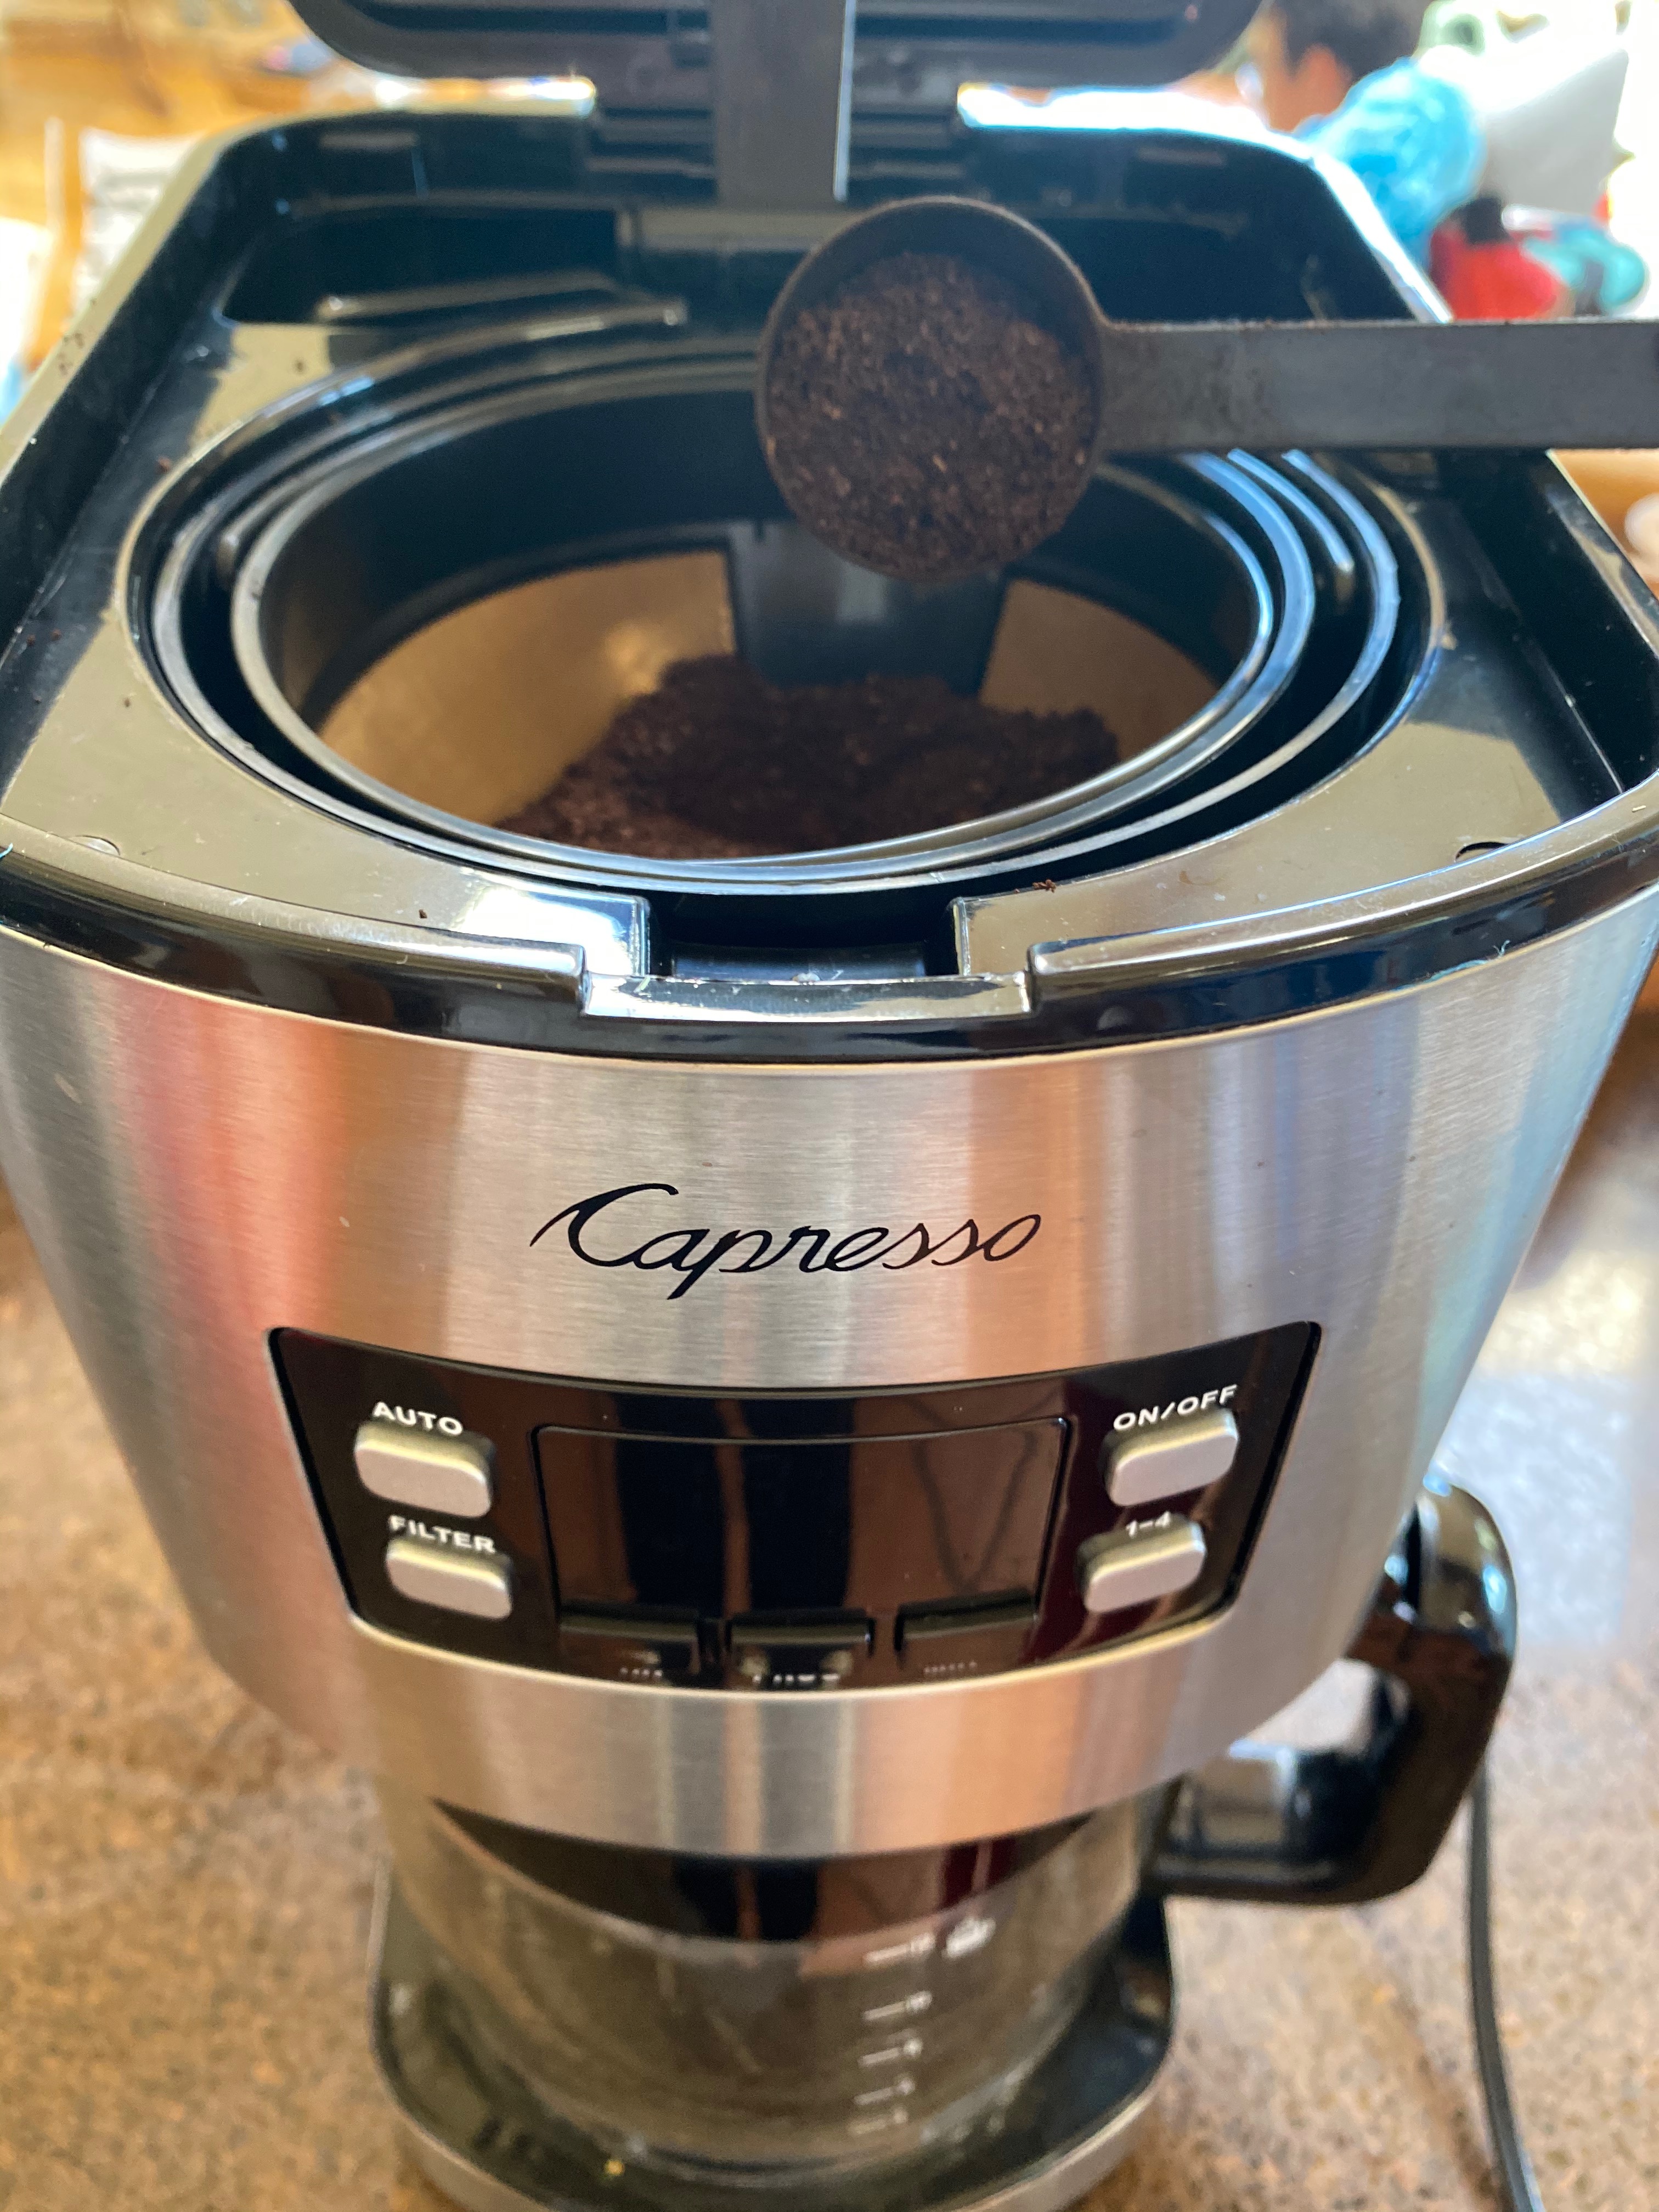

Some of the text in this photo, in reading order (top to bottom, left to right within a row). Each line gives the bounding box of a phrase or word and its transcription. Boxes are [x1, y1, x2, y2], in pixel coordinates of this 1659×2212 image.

[530, 1183, 1041, 1300] Capresso
[373, 1401, 463, 1435] AUTO
[1113, 1384, 1237, 1431] ON/OFF
[388, 1514, 495, 1553] FILTER
[1126, 1511, 1171, 1537] 1-4
